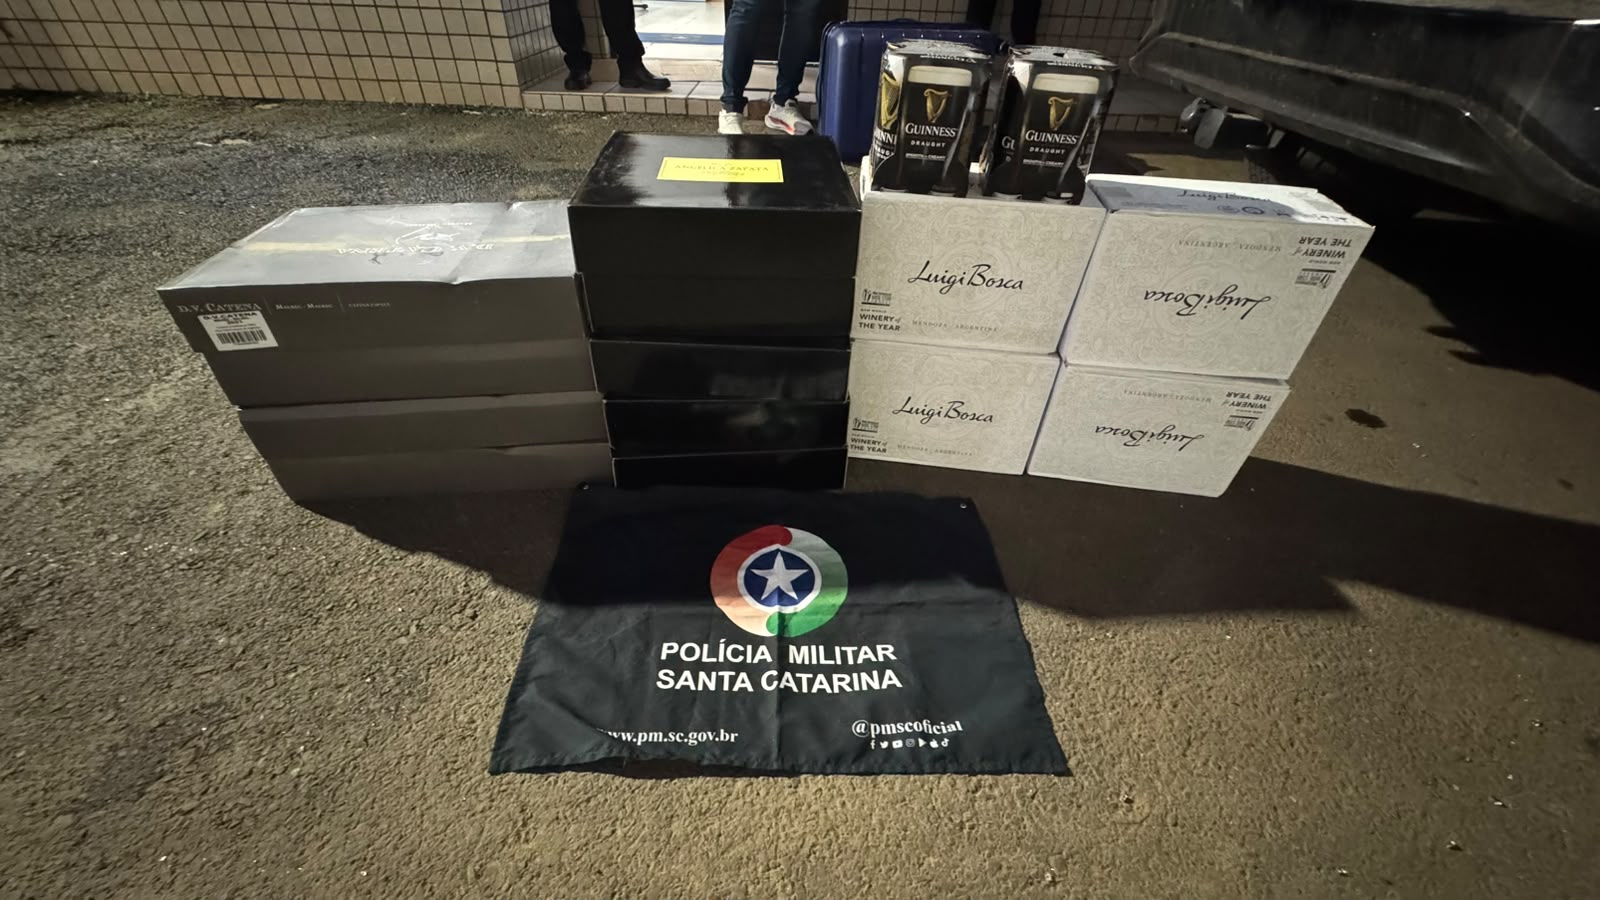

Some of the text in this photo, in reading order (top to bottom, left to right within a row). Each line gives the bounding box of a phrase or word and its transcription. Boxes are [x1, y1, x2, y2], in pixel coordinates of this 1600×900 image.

[905, 122, 957, 137] GUINNESS
[1025, 129, 1078, 144] GUINNESS
[910, 140, 946, 148] DRAUGHT
[1029, 146, 1065, 155] DRAUGHT
[1298, 236, 1352, 248] THE YEAR
[1302, 248, 1346, 259] WINERY
[177, 303, 262, 313] D.V. CATENA
[859, 313, 895, 322] WINERY
[858, 321, 901, 332] THE YEAR
[1226, 391, 1272, 402] THE YEAR
[1229, 401, 1267, 410] WINERY
[851, 437, 881, 446] WINERY
[866, 446, 888, 454] YEAR
[660, 638, 898, 665] POLÍCIA MILITAR
[656, 668, 903, 694] SANTA CATARINA
[851, 718, 963, 739] @pmscoficial
